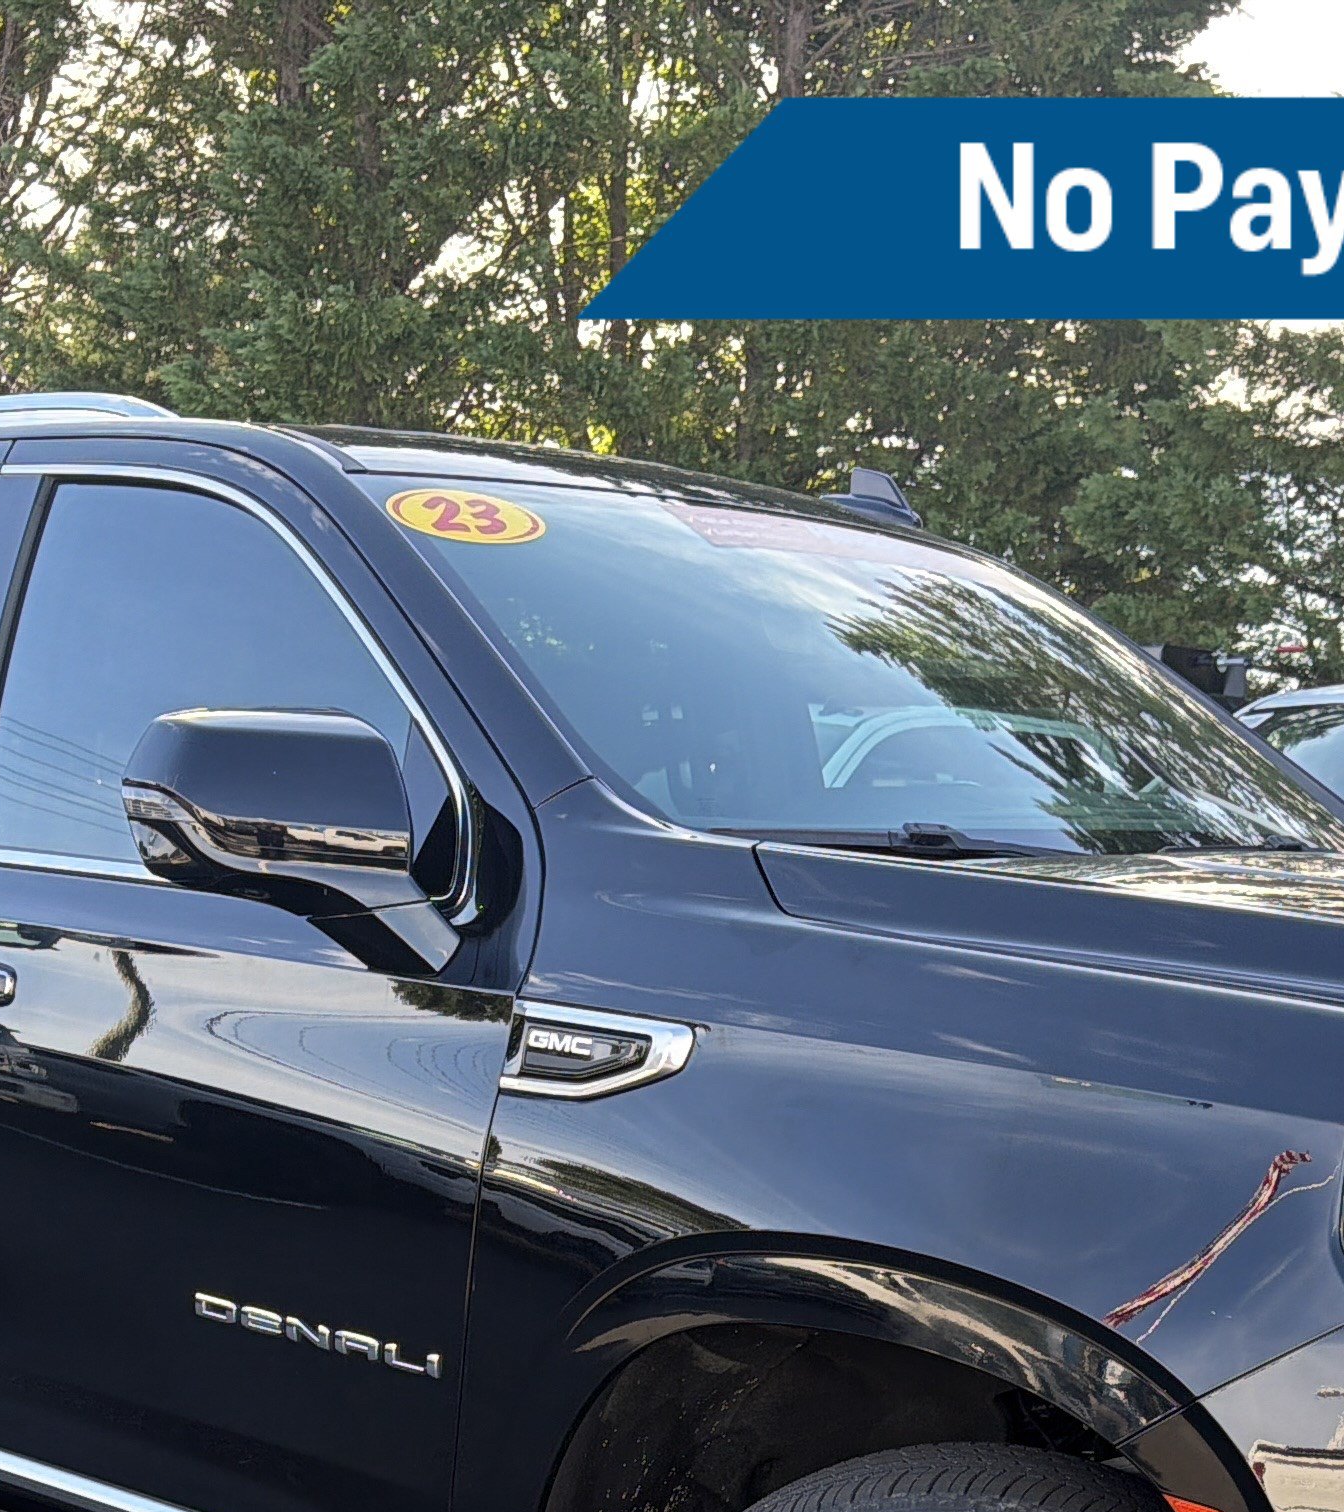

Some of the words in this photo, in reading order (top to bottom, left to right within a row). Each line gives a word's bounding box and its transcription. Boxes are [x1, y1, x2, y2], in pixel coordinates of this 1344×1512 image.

[422, 496, 507, 535] 23
[528, 1029, 593, 1056] GMC
[194, 1292, 442, 1379] DENALI
